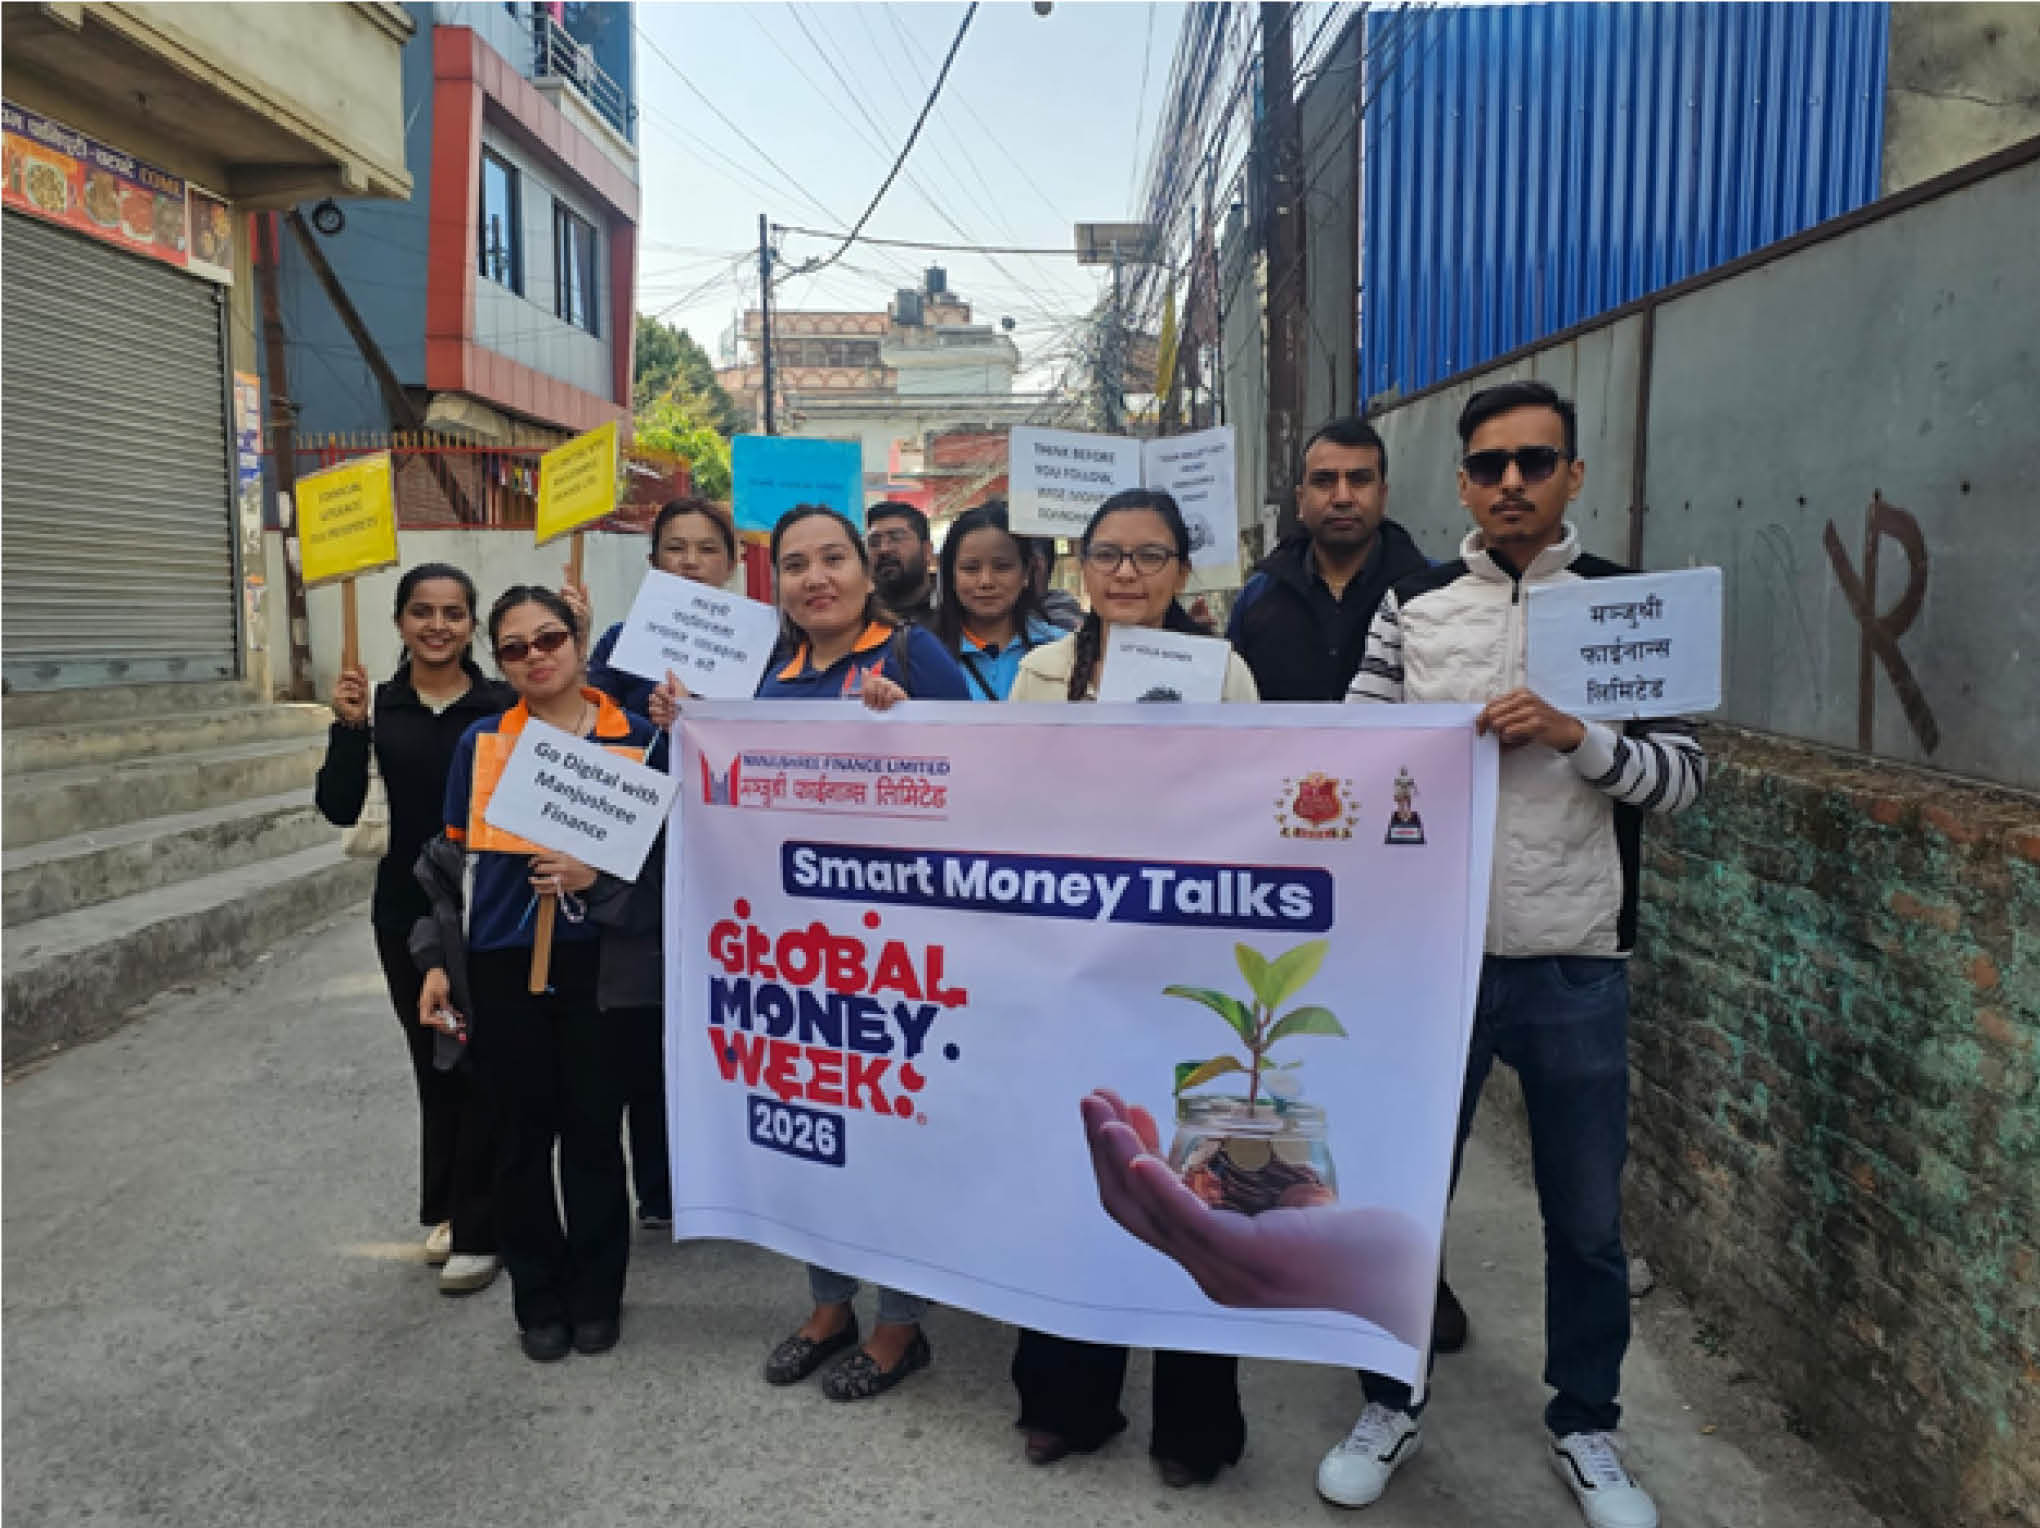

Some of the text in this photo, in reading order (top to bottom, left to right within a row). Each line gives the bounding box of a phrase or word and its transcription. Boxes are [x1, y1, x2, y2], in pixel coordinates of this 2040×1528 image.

[1033, 441, 1115, 464] THINK BEFORE
[533, 742, 660, 806] Go Digital with
[886, 760, 950, 776] LIMITED
[534, 769, 637, 826] Manjushree
[540, 801, 608, 842] Finance
[793, 847, 1314, 920] Smart Money Talks
[708, 917, 970, 1008] GLOBAL
[708, 974, 942, 1061] MONEY
[754, 1101, 837, 1156] 2026
